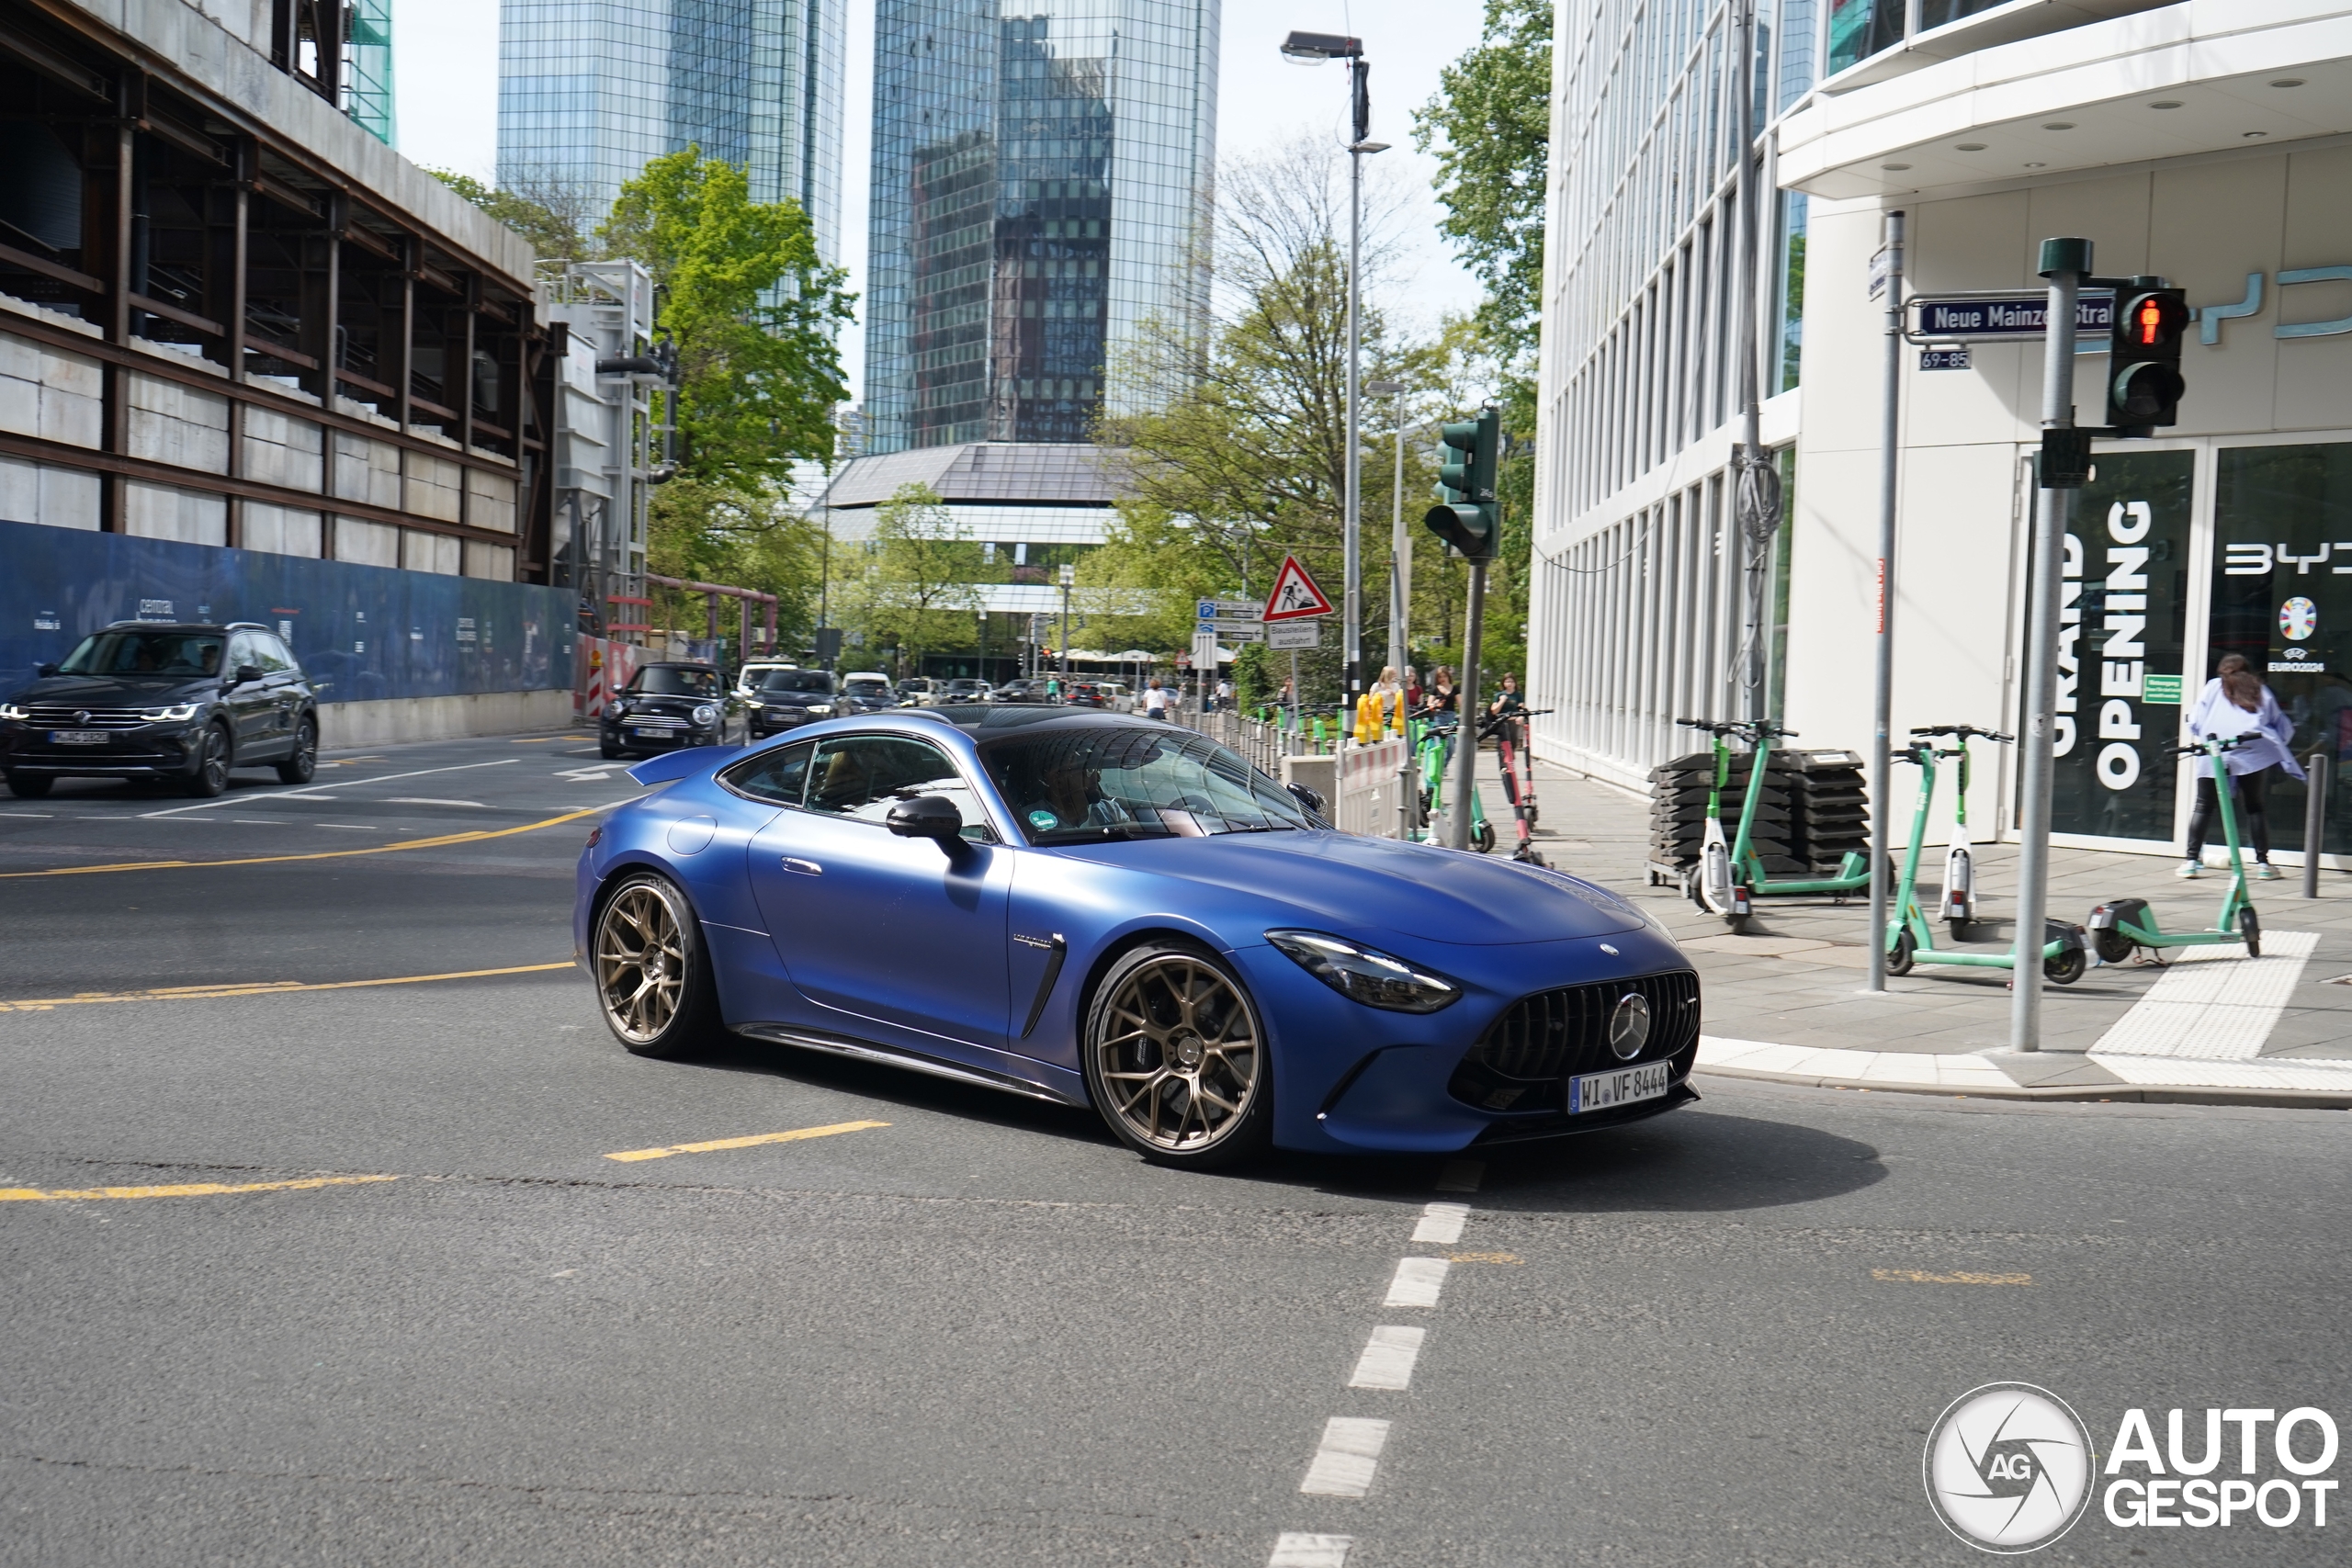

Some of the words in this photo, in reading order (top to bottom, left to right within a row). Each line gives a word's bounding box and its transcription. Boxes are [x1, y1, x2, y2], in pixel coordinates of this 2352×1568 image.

[1935, 307, 1982, 329] Neue
[1988, 303, 2048, 327] Mainze
[1922, 353, 1969, 367] 69-85
[2097, 501, 2152, 790] OPENING
[1582, 1078, 1600, 1108] WI
[1612, 1073, 1631, 1102] VF
[1634, 1066, 1666, 1098] 8444
